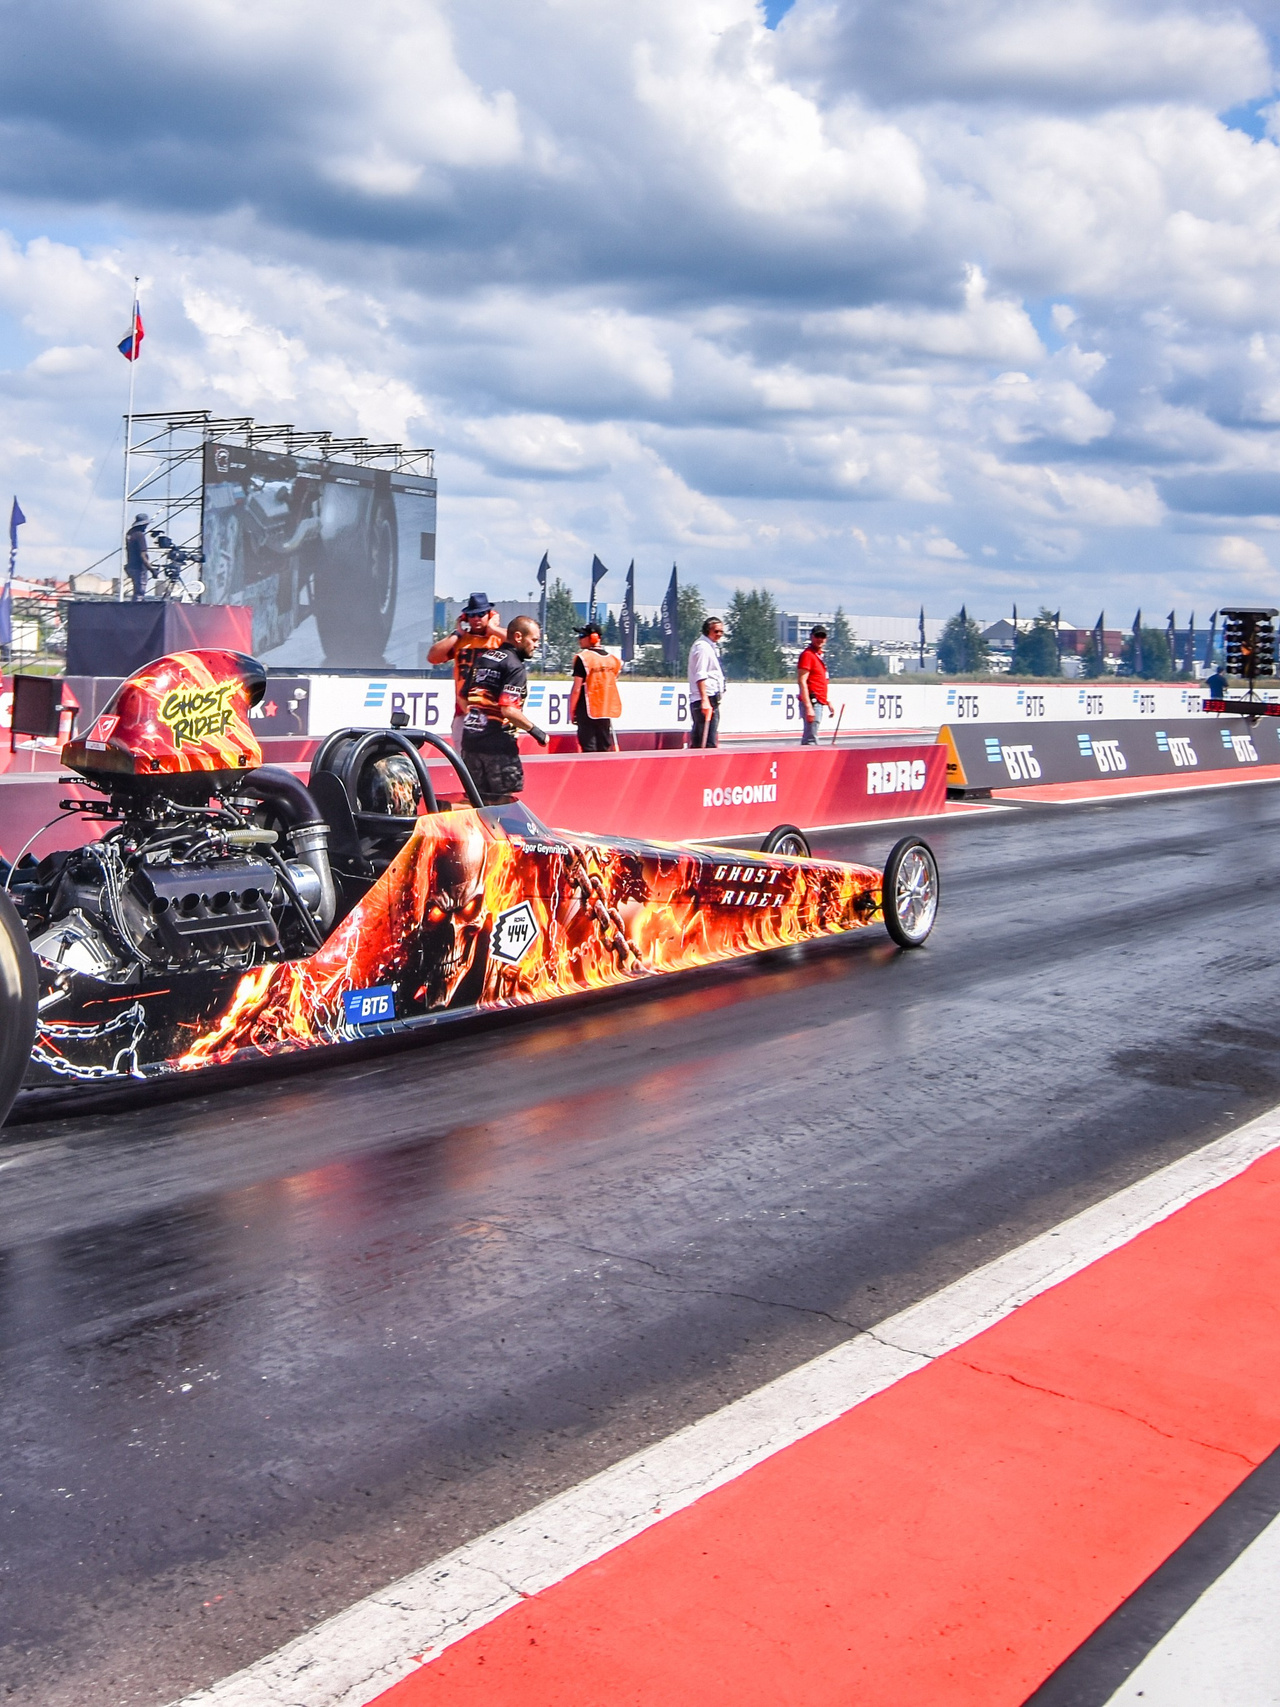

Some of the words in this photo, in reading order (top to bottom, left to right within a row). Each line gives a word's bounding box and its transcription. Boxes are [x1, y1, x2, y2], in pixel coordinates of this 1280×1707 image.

[162, 686, 231, 720] GHOST
[391, 692, 439, 726] ВТБ
[879, 694, 903, 719] ВТБ
[957, 695, 979, 718] ВТБ
[1026, 695, 1045, 717] ВТБ
[1086, 695, 1103, 715] ВТБ
[173, 709, 236, 748] RIDER
[1091, 740, 1127, 773] ВТБ
[1167, 737, 1198, 766] ВТБ
[1231, 735, 1258, 762] ВТБ
[1001, 745, 1042, 780] ВТБ
[867, 760, 926, 794] RDRC
[703, 784, 777, 807] ROSGONKI
[522, 842, 537, 854] Igor
[714, 865, 781, 884] GHOST
[720, 890, 785, 908] RIDER
[507, 923, 529, 943] 444
[361, 995, 389, 1016] ВТБ
